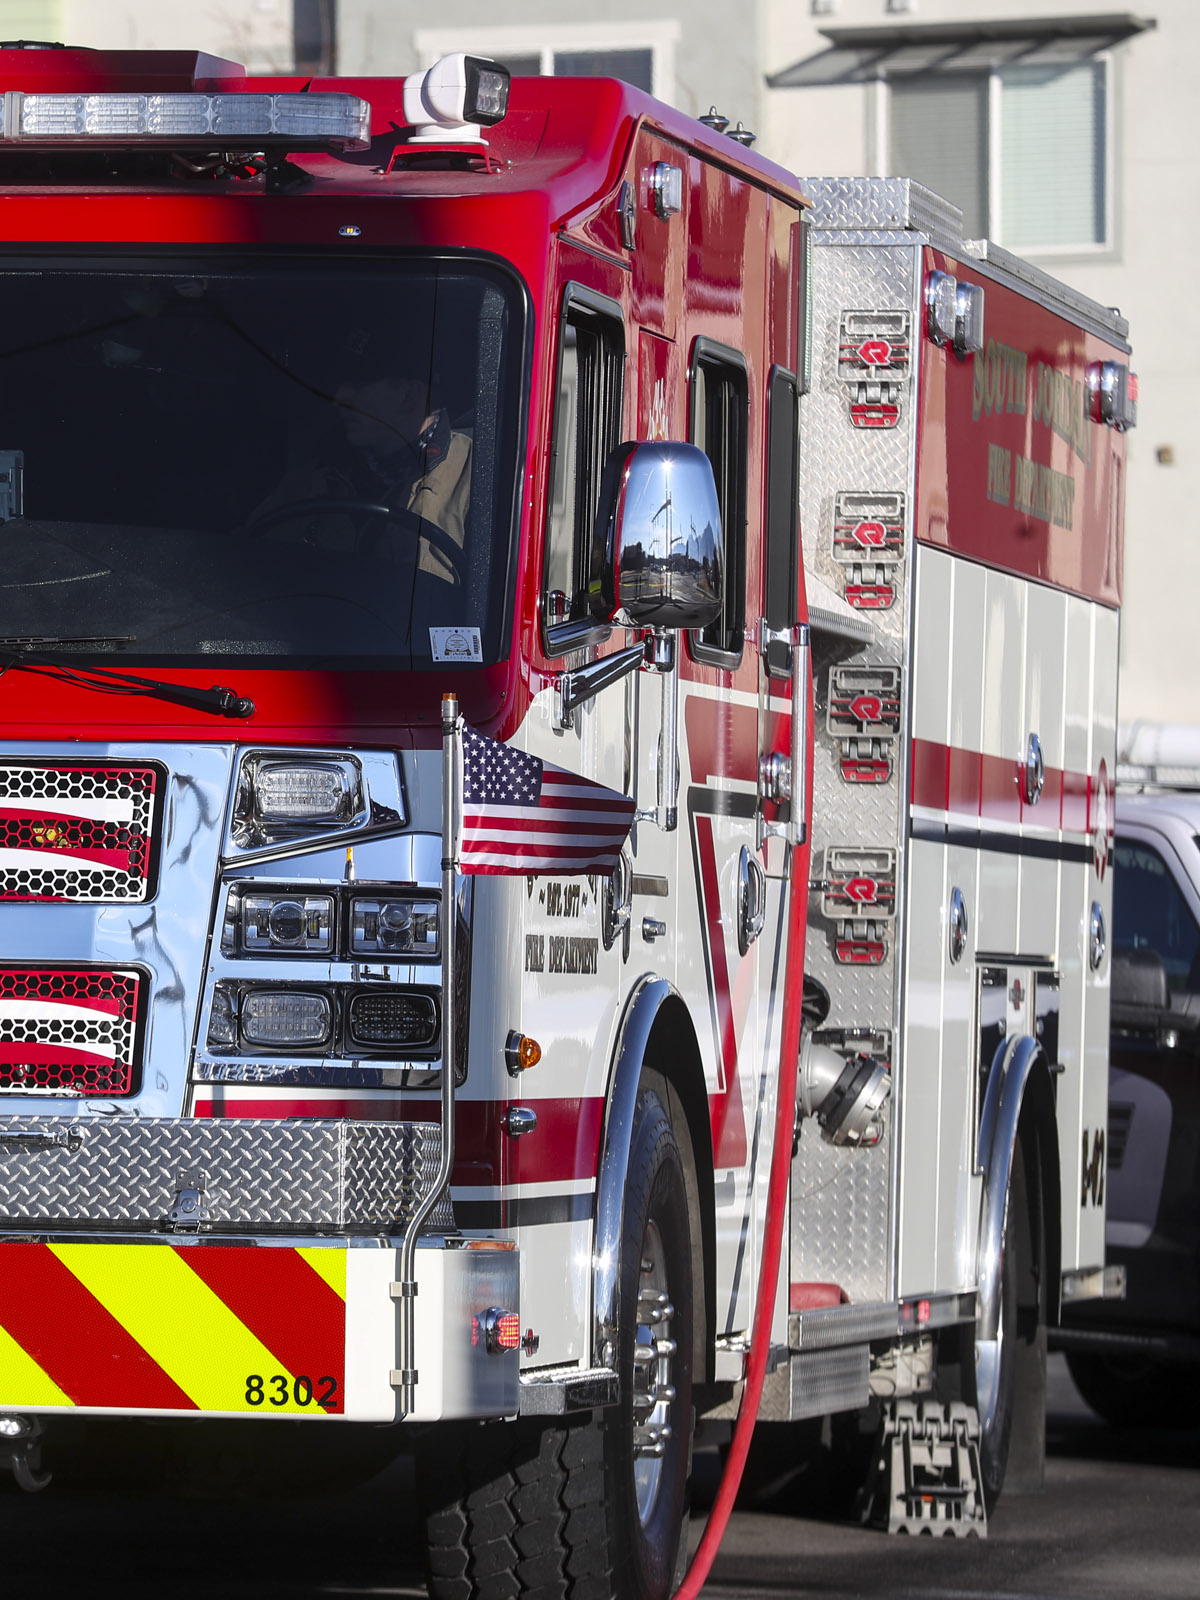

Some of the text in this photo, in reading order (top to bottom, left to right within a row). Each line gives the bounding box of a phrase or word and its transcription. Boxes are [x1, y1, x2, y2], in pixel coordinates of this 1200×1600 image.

[972, 337, 1029, 421] SOUTH
[987, 442, 1012, 507] FIRE
[525, 934, 599, 975] FIRE DEPARTMENT
[245, 1374, 338, 1407] 8302
